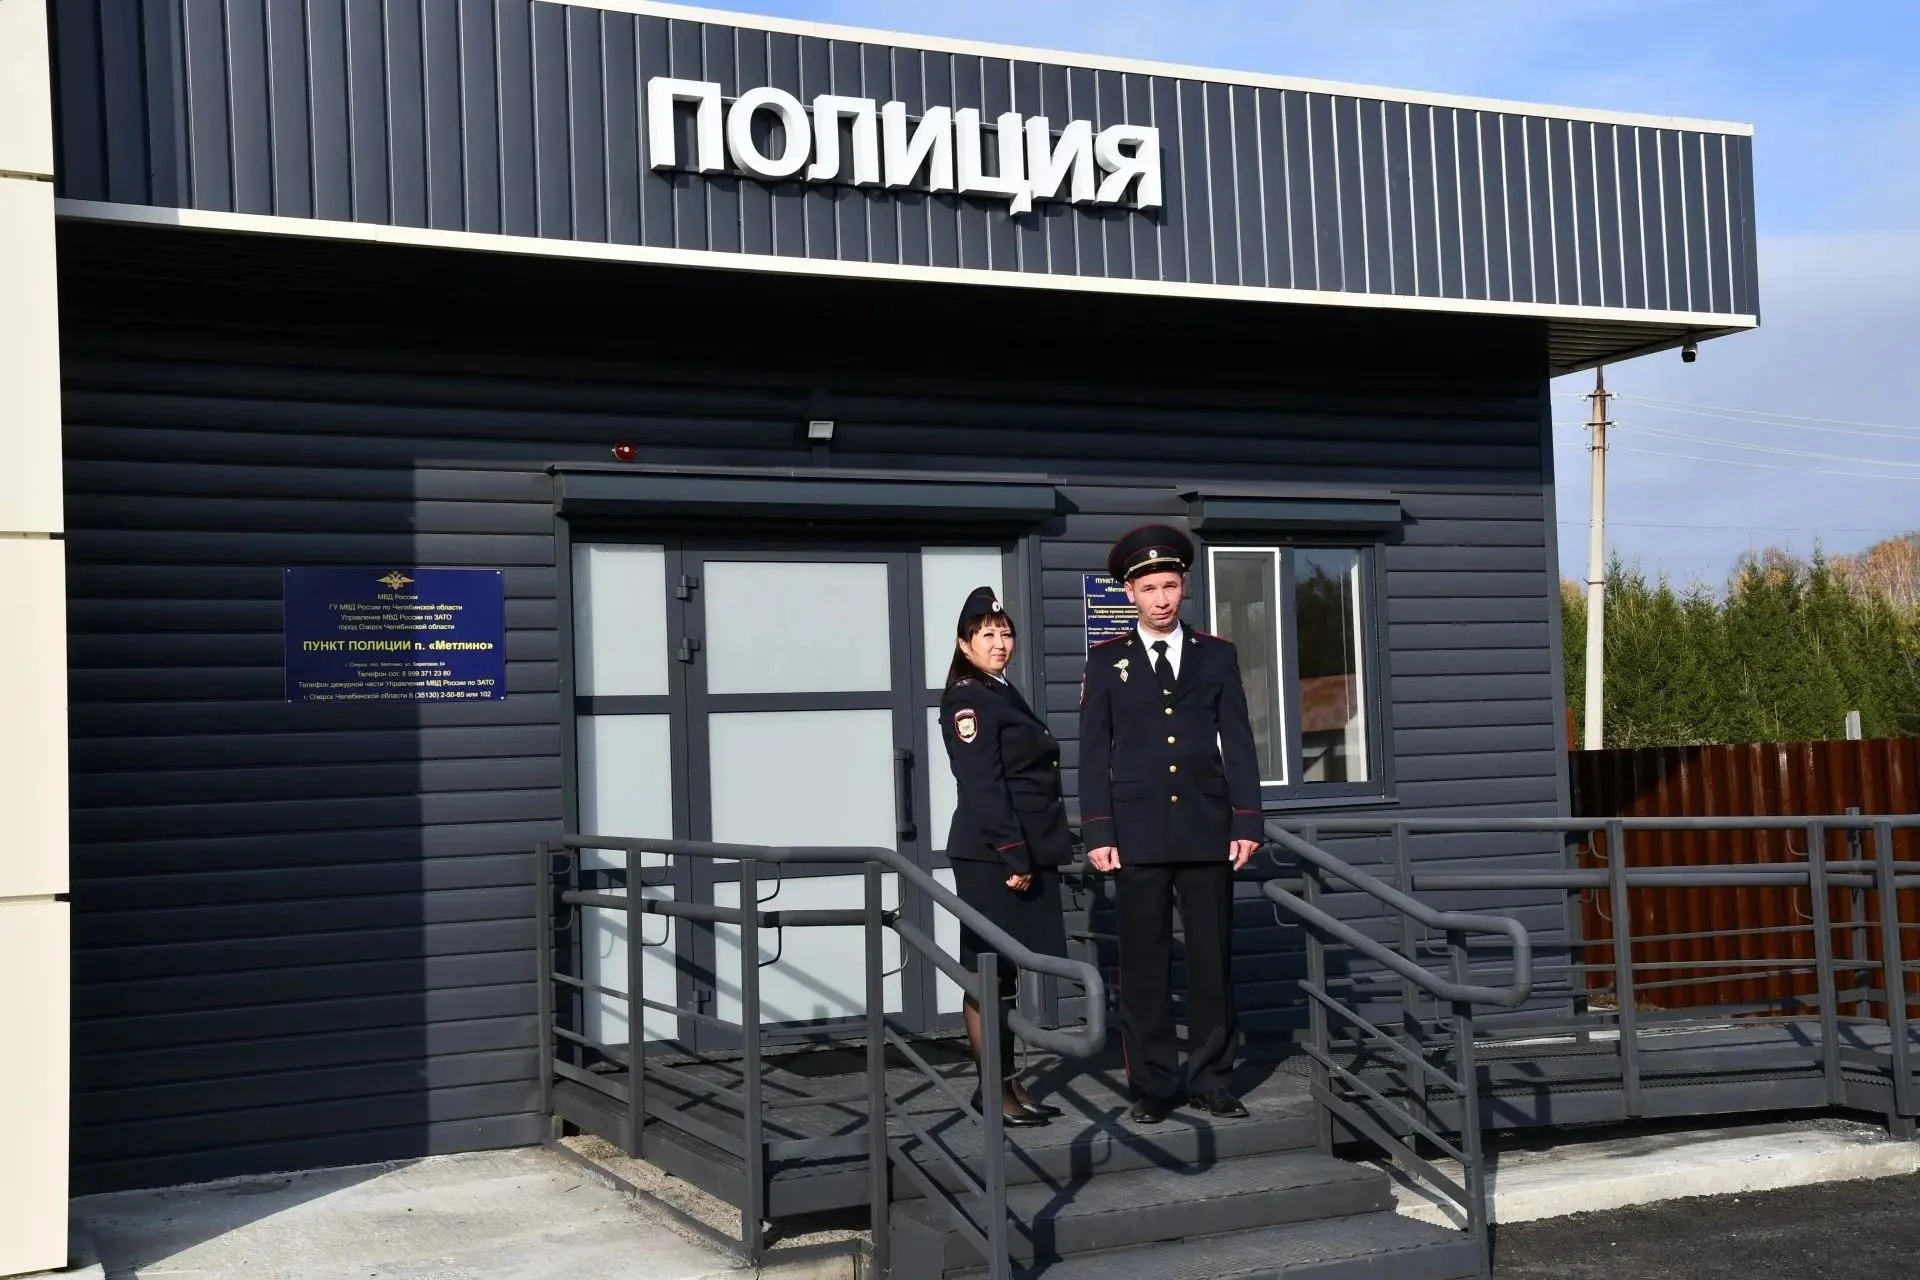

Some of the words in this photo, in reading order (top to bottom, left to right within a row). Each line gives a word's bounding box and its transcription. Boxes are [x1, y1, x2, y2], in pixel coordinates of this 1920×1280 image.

[648, 76, 1162, 216] ПОЛИЦИЯ
[377, 593, 394, 601] МВД
[395, 593, 418, 601] России
[329, 603, 338, 611] ГУ
[339, 603, 356, 611] МВД
[357, 603, 381, 611] России
[392, 603, 435, 611] Челябинской
[436, 603, 463, 611] области
[341, 614, 381, 622] Управление
[303, 640, 345, 651] ПУНКТ
[348, 640, 411, 652] ПОЛИЦИИ
[414, 642, 425, 651] п.
[428, 640, 494, 651] «Метлино»
[385, 680, 425, 688] Управления
